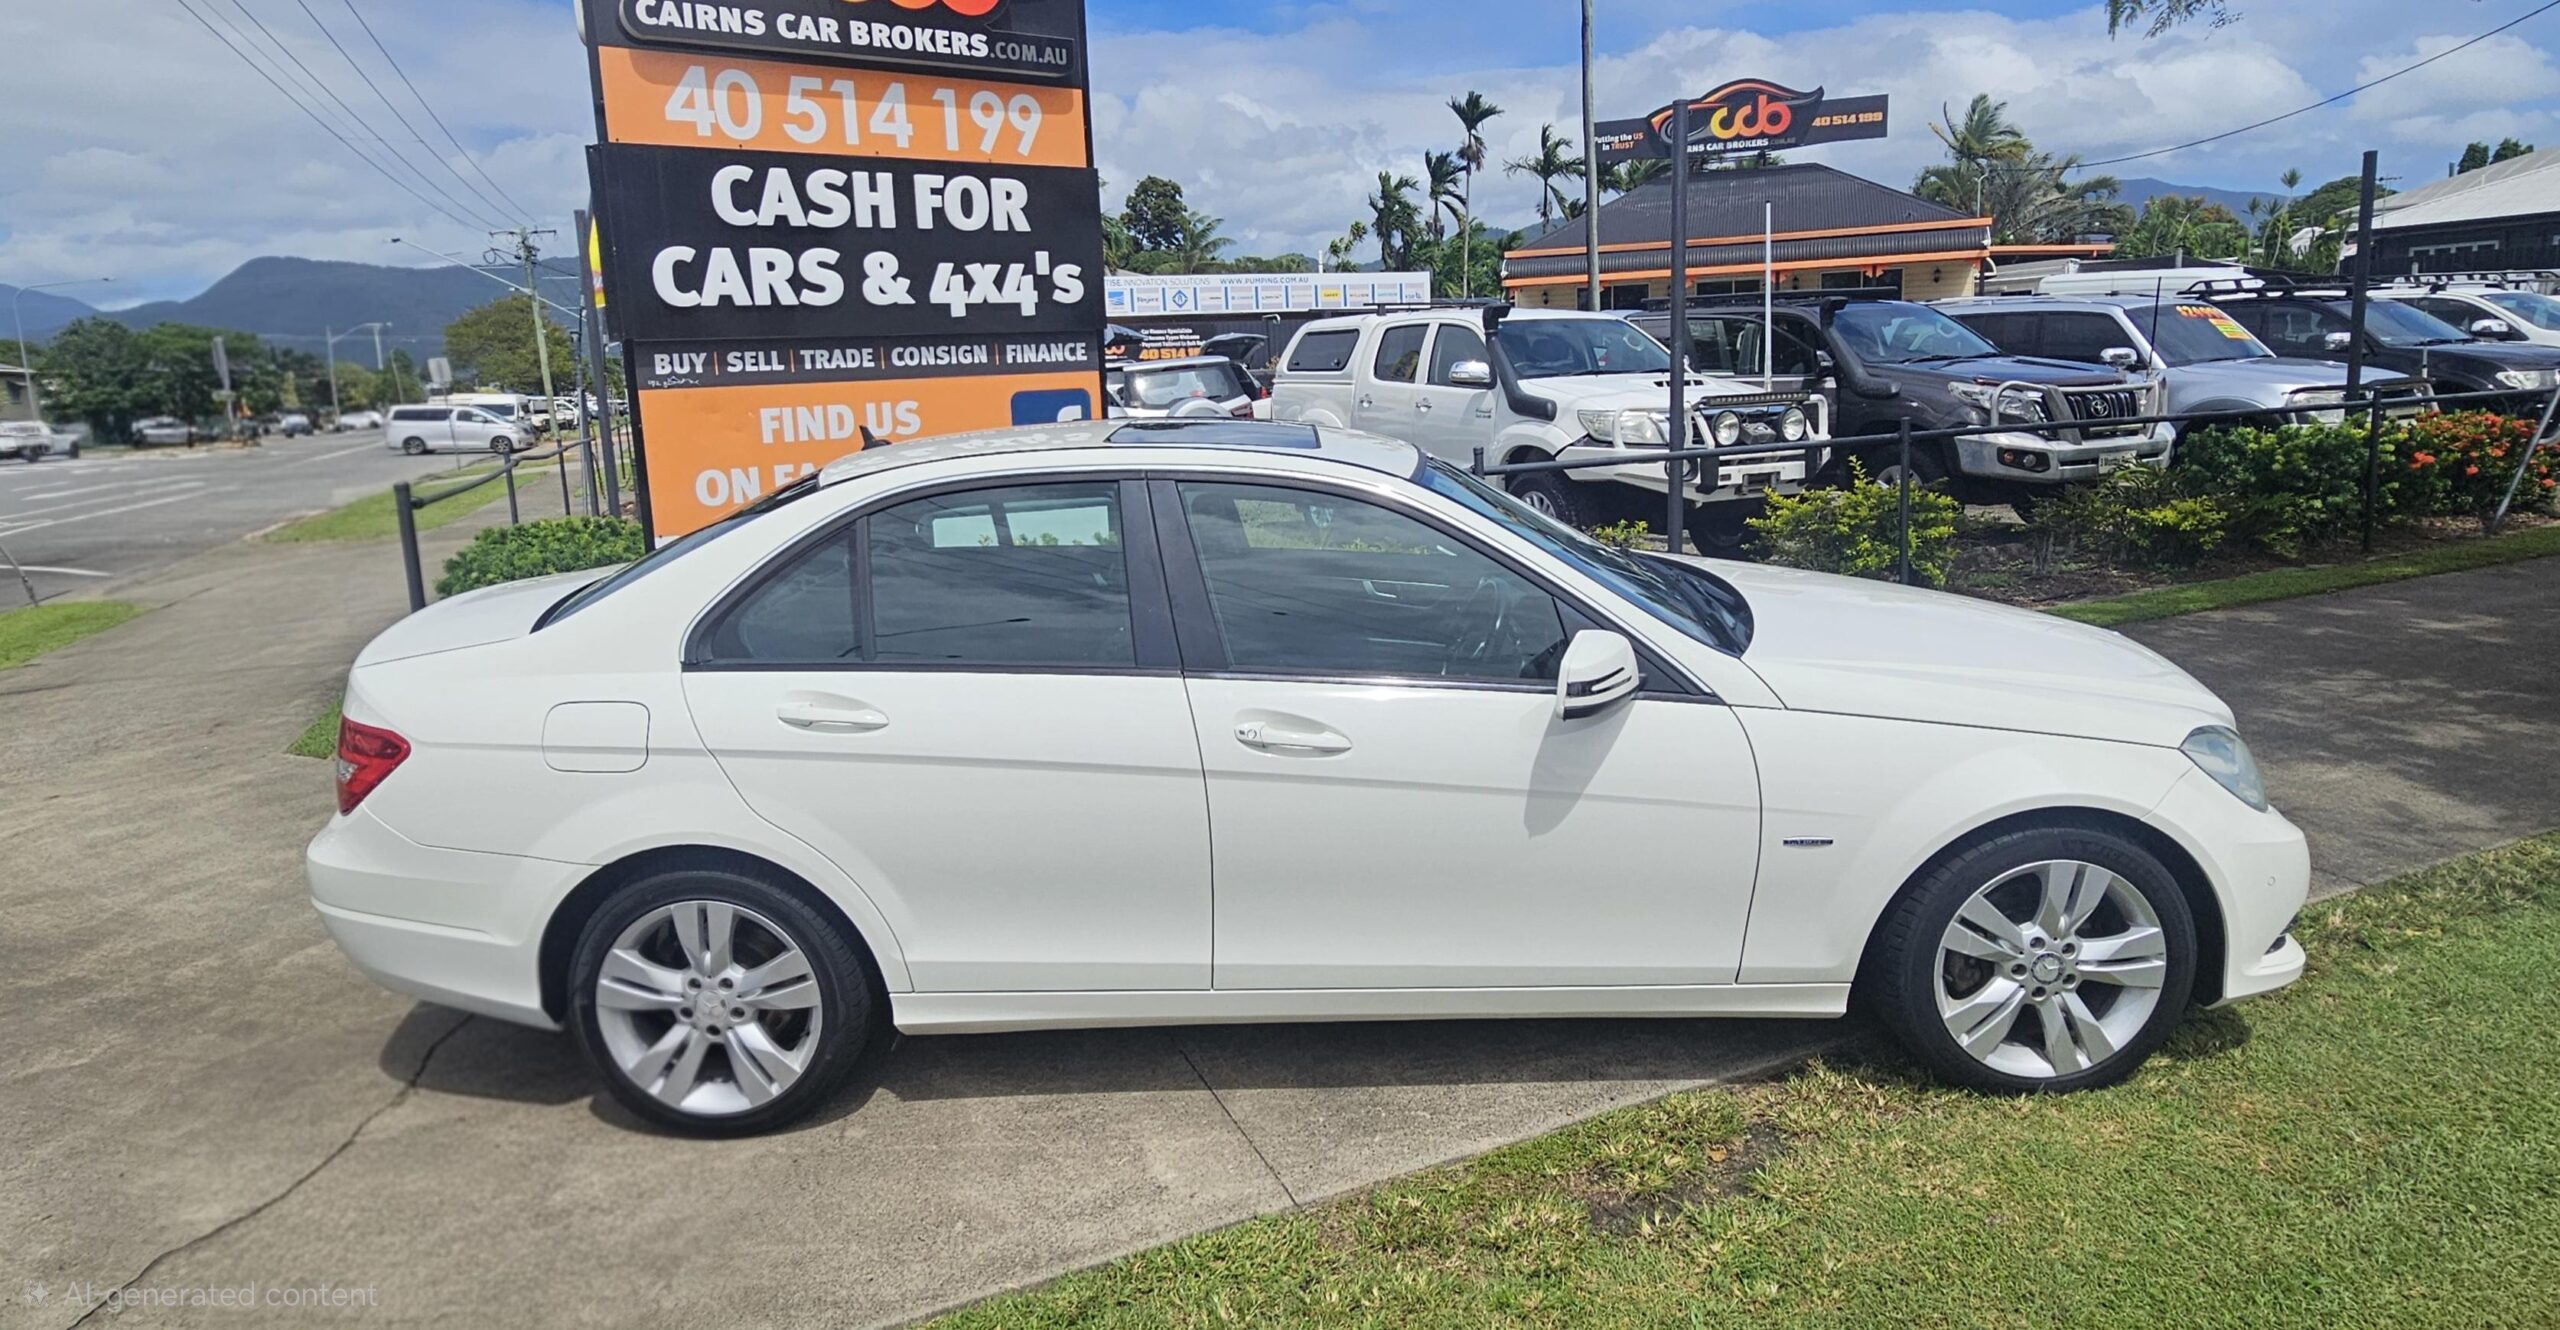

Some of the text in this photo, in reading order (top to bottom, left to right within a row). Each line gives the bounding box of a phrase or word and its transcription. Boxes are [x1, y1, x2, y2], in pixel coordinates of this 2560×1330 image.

[636, 0, 766, 36] CAIRNS
[776, 12, 842, 44] CAR
[665, 65, 1042, 156] 40 514 199
[1611, 141, 1635, 150] TRUST
[1633, 132, 1644, 140] US
[1706, 142, 1724, 151] CAR
[711, 164, 1032, 232] CASH FOR
[652, 246, 845, 308] CARS
[863, 250, 916, 306] &
[653, 353, 708, 375] BUY
[726, 351, 785, 373] SELL
[799, 348, 876, 370] TRADE
[891, 344, 988, 367] CONSIGN
[1006, 341, 1088, 364] FINANCE
[759, 400, 922, 444] FIND US
[695, 466, 762, 507] ON
